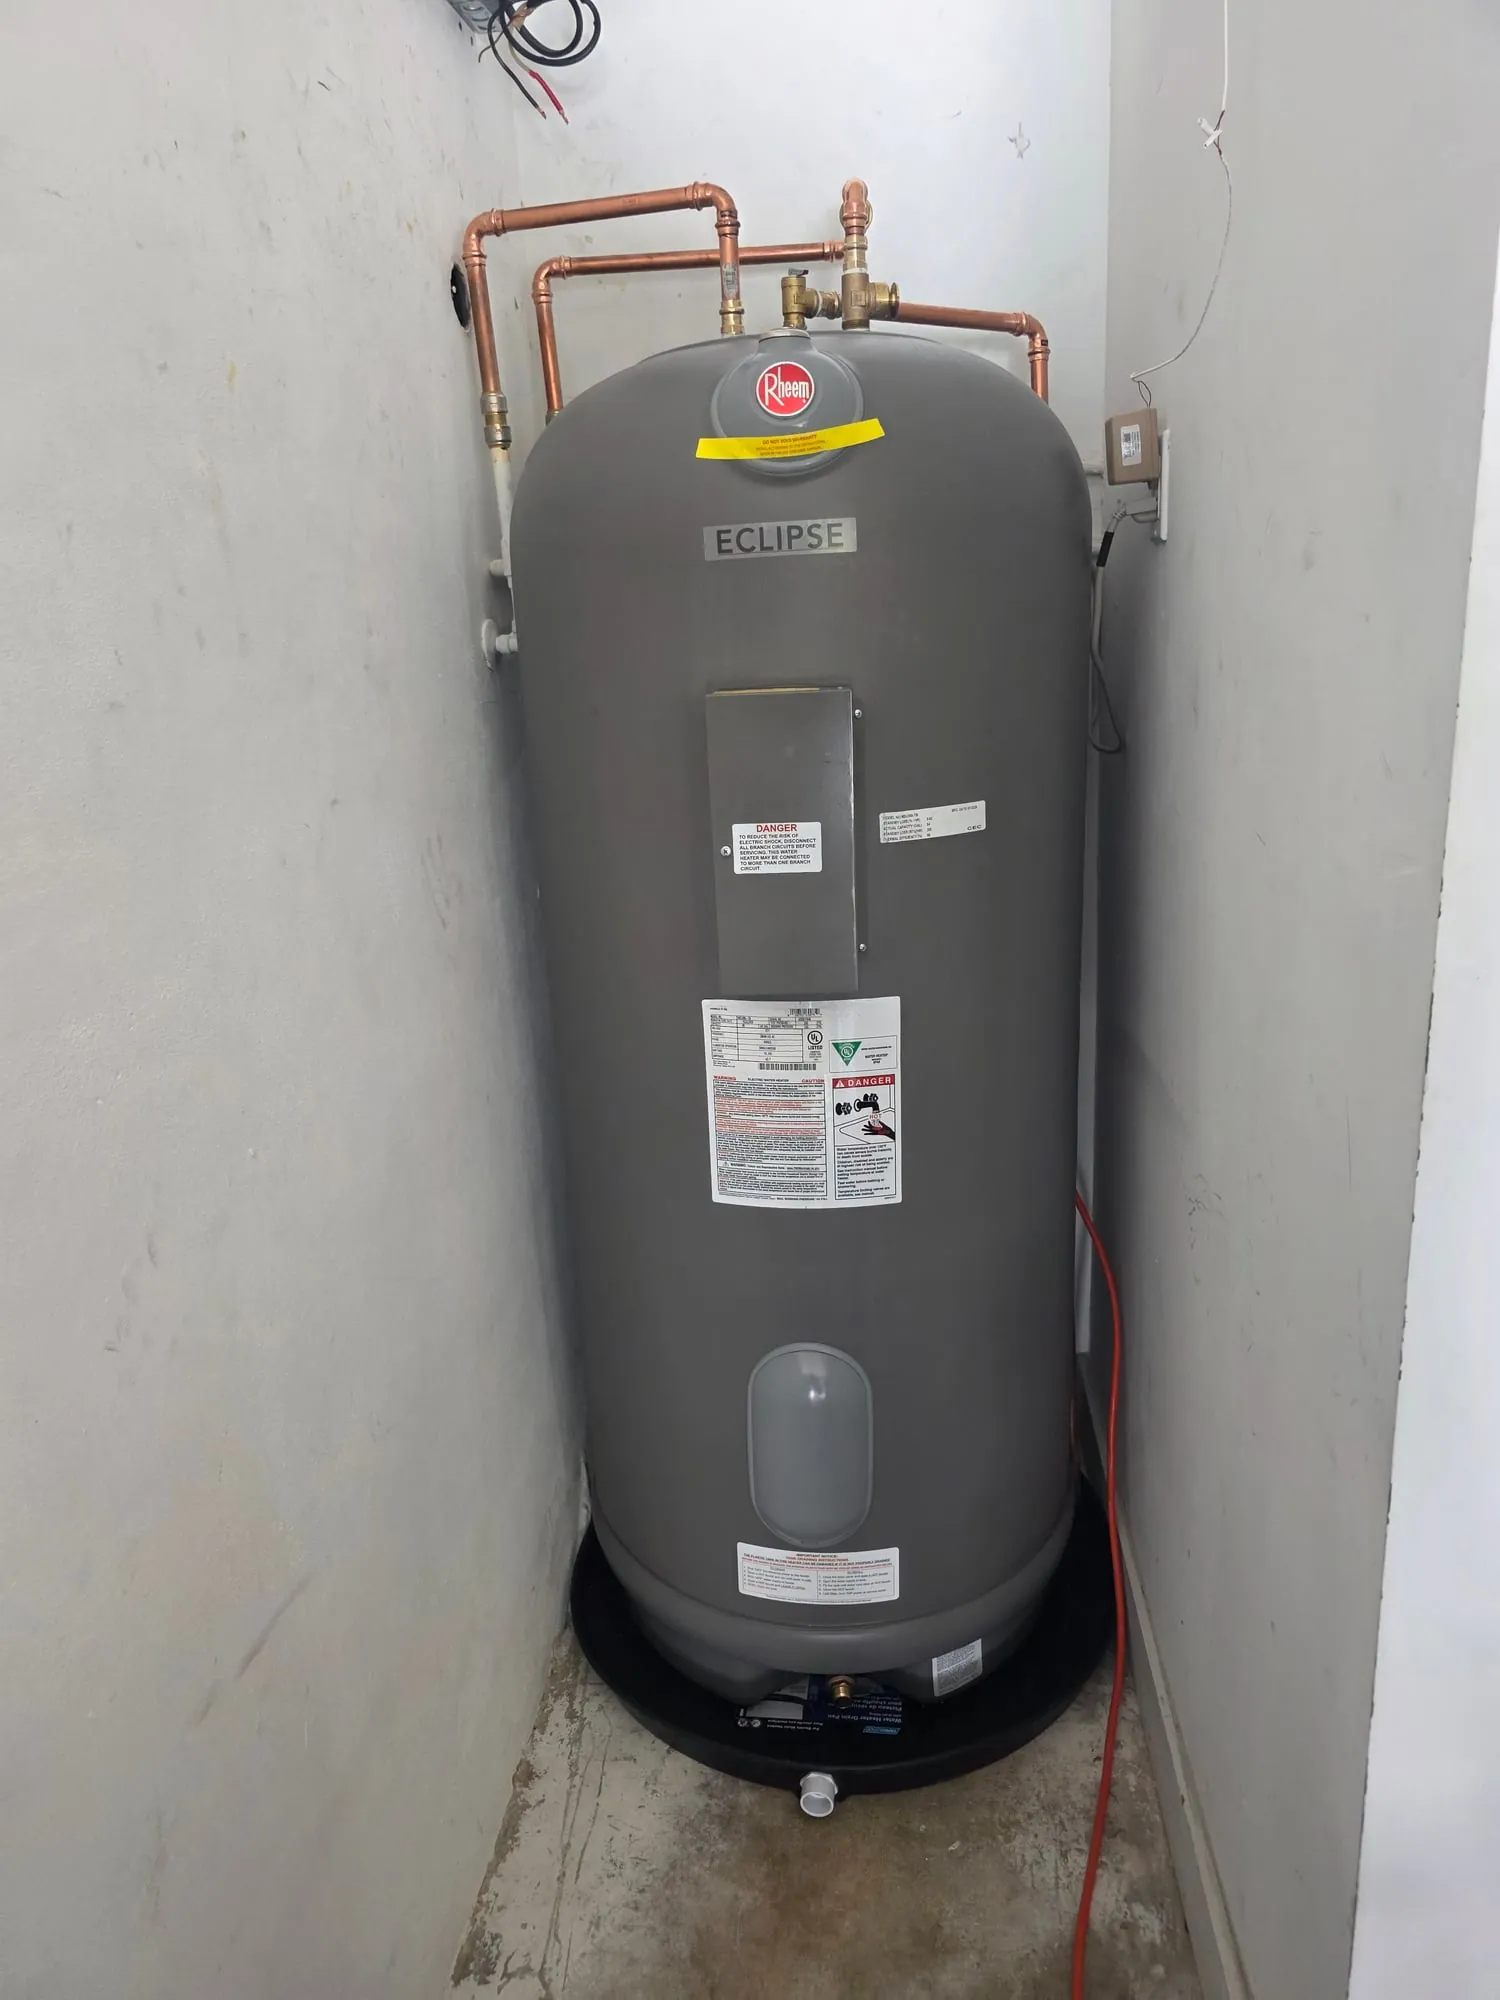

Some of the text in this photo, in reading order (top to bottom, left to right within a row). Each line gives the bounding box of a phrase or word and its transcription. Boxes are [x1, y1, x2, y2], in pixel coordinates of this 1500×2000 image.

[764, 366, 810, 406] Rheem
[716, 522, 844, 554] ECLIPSE
[756, 824, 797, 832] DANGER
[811, 1034, 819, 1042] UL
[848, 1076, 891, 1086] DANGER
